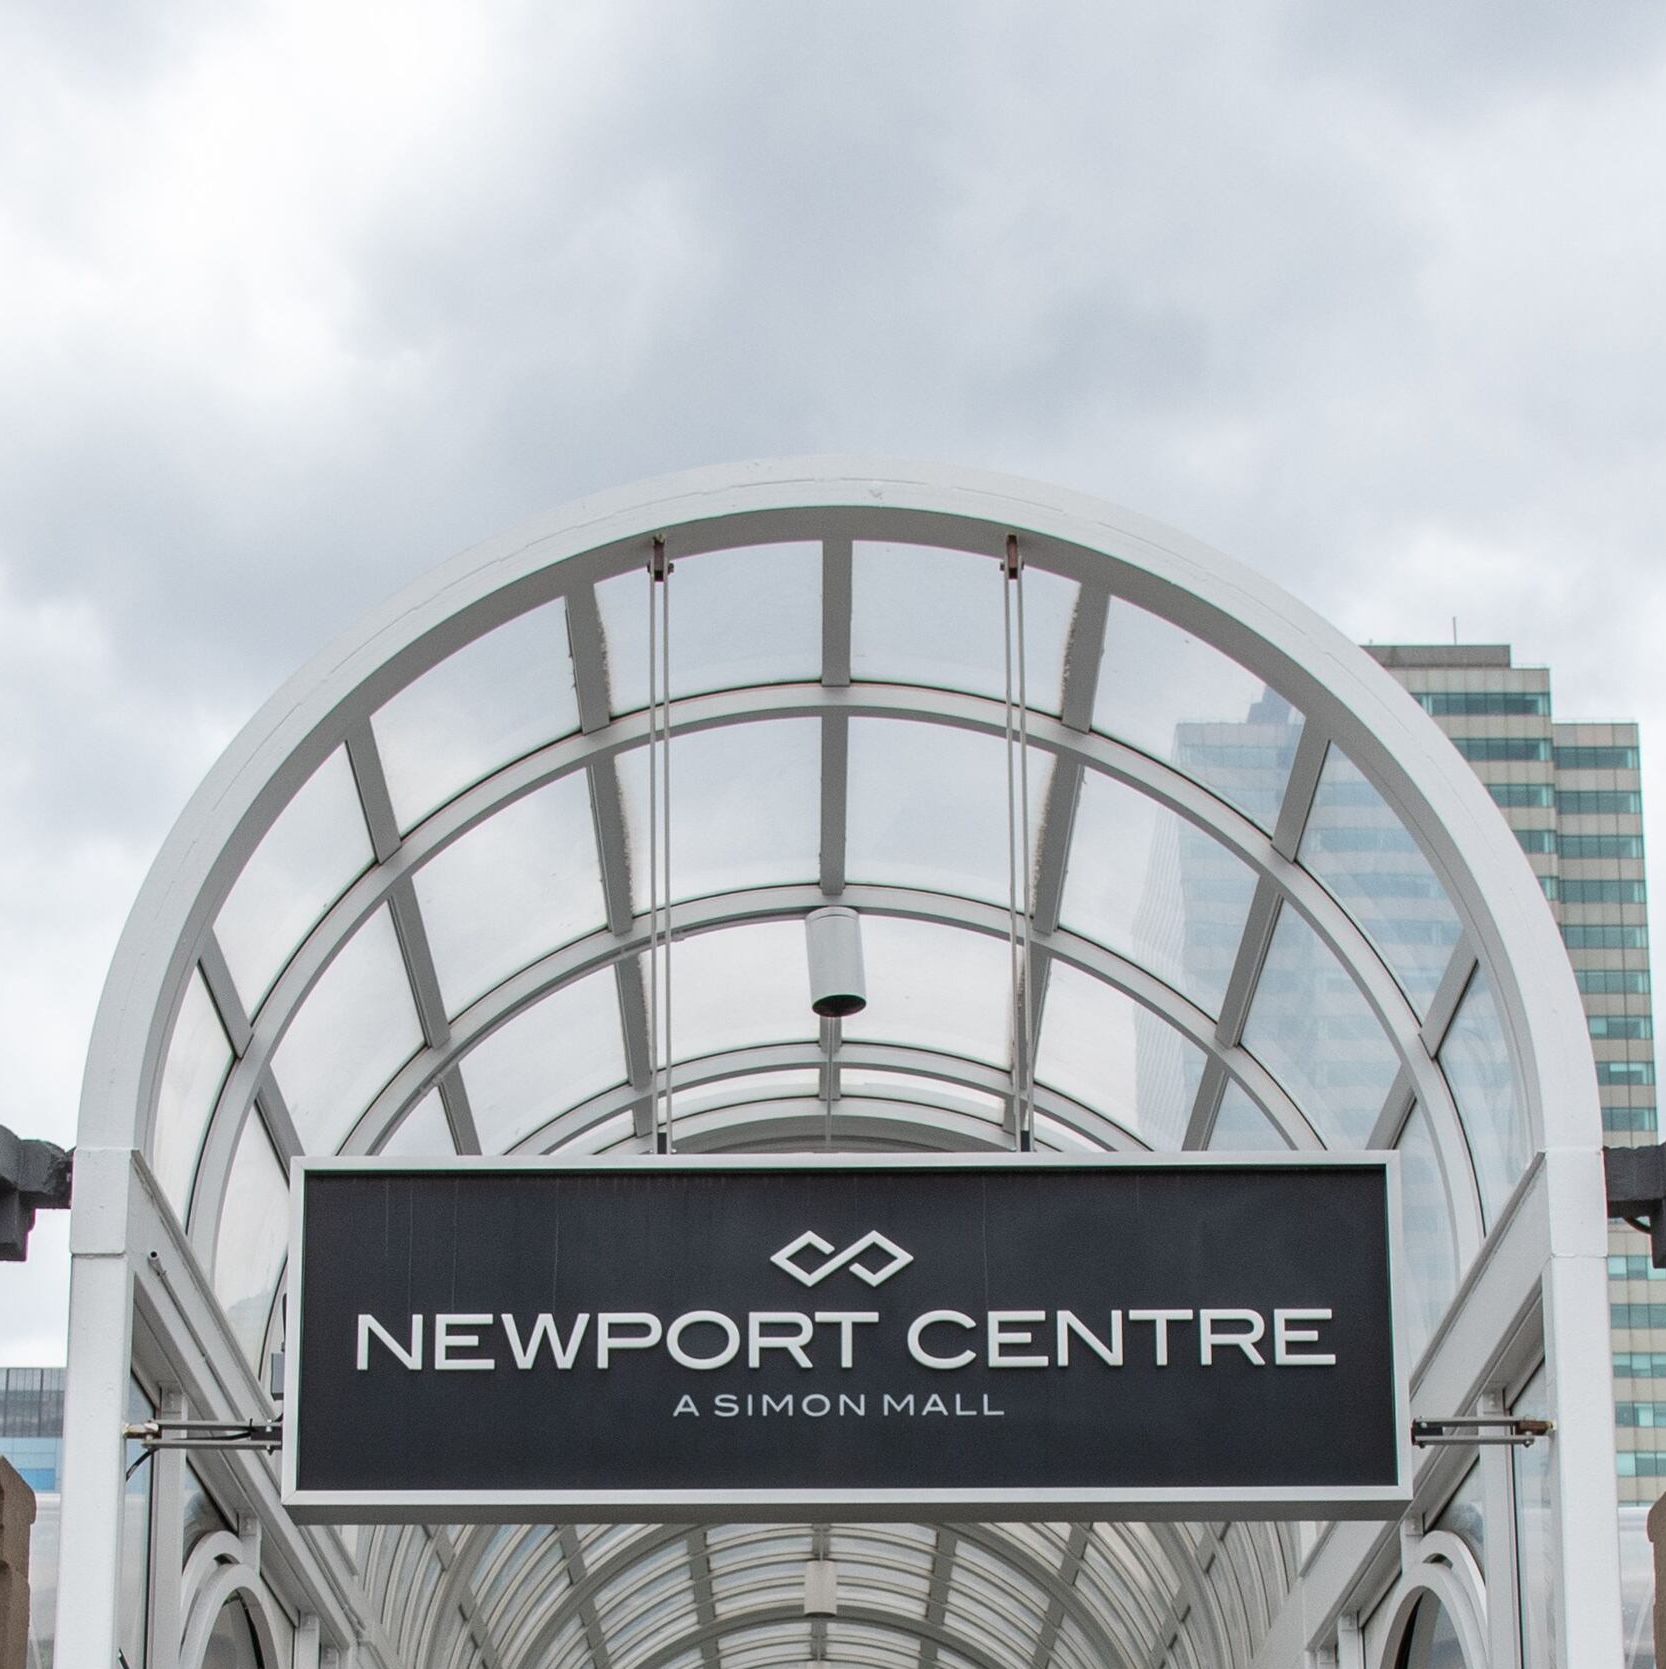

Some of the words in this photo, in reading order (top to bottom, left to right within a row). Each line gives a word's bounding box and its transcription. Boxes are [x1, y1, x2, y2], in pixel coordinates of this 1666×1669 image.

[356, 1311, 880, 1371] NEWPORT
[907, 1308, 1336, 1369] CENTRE
[672, 1394, 700, 1417] A
[714, 1393, 866, 1417] SIMON
[883, 1393, 1005, 1416] MALL
